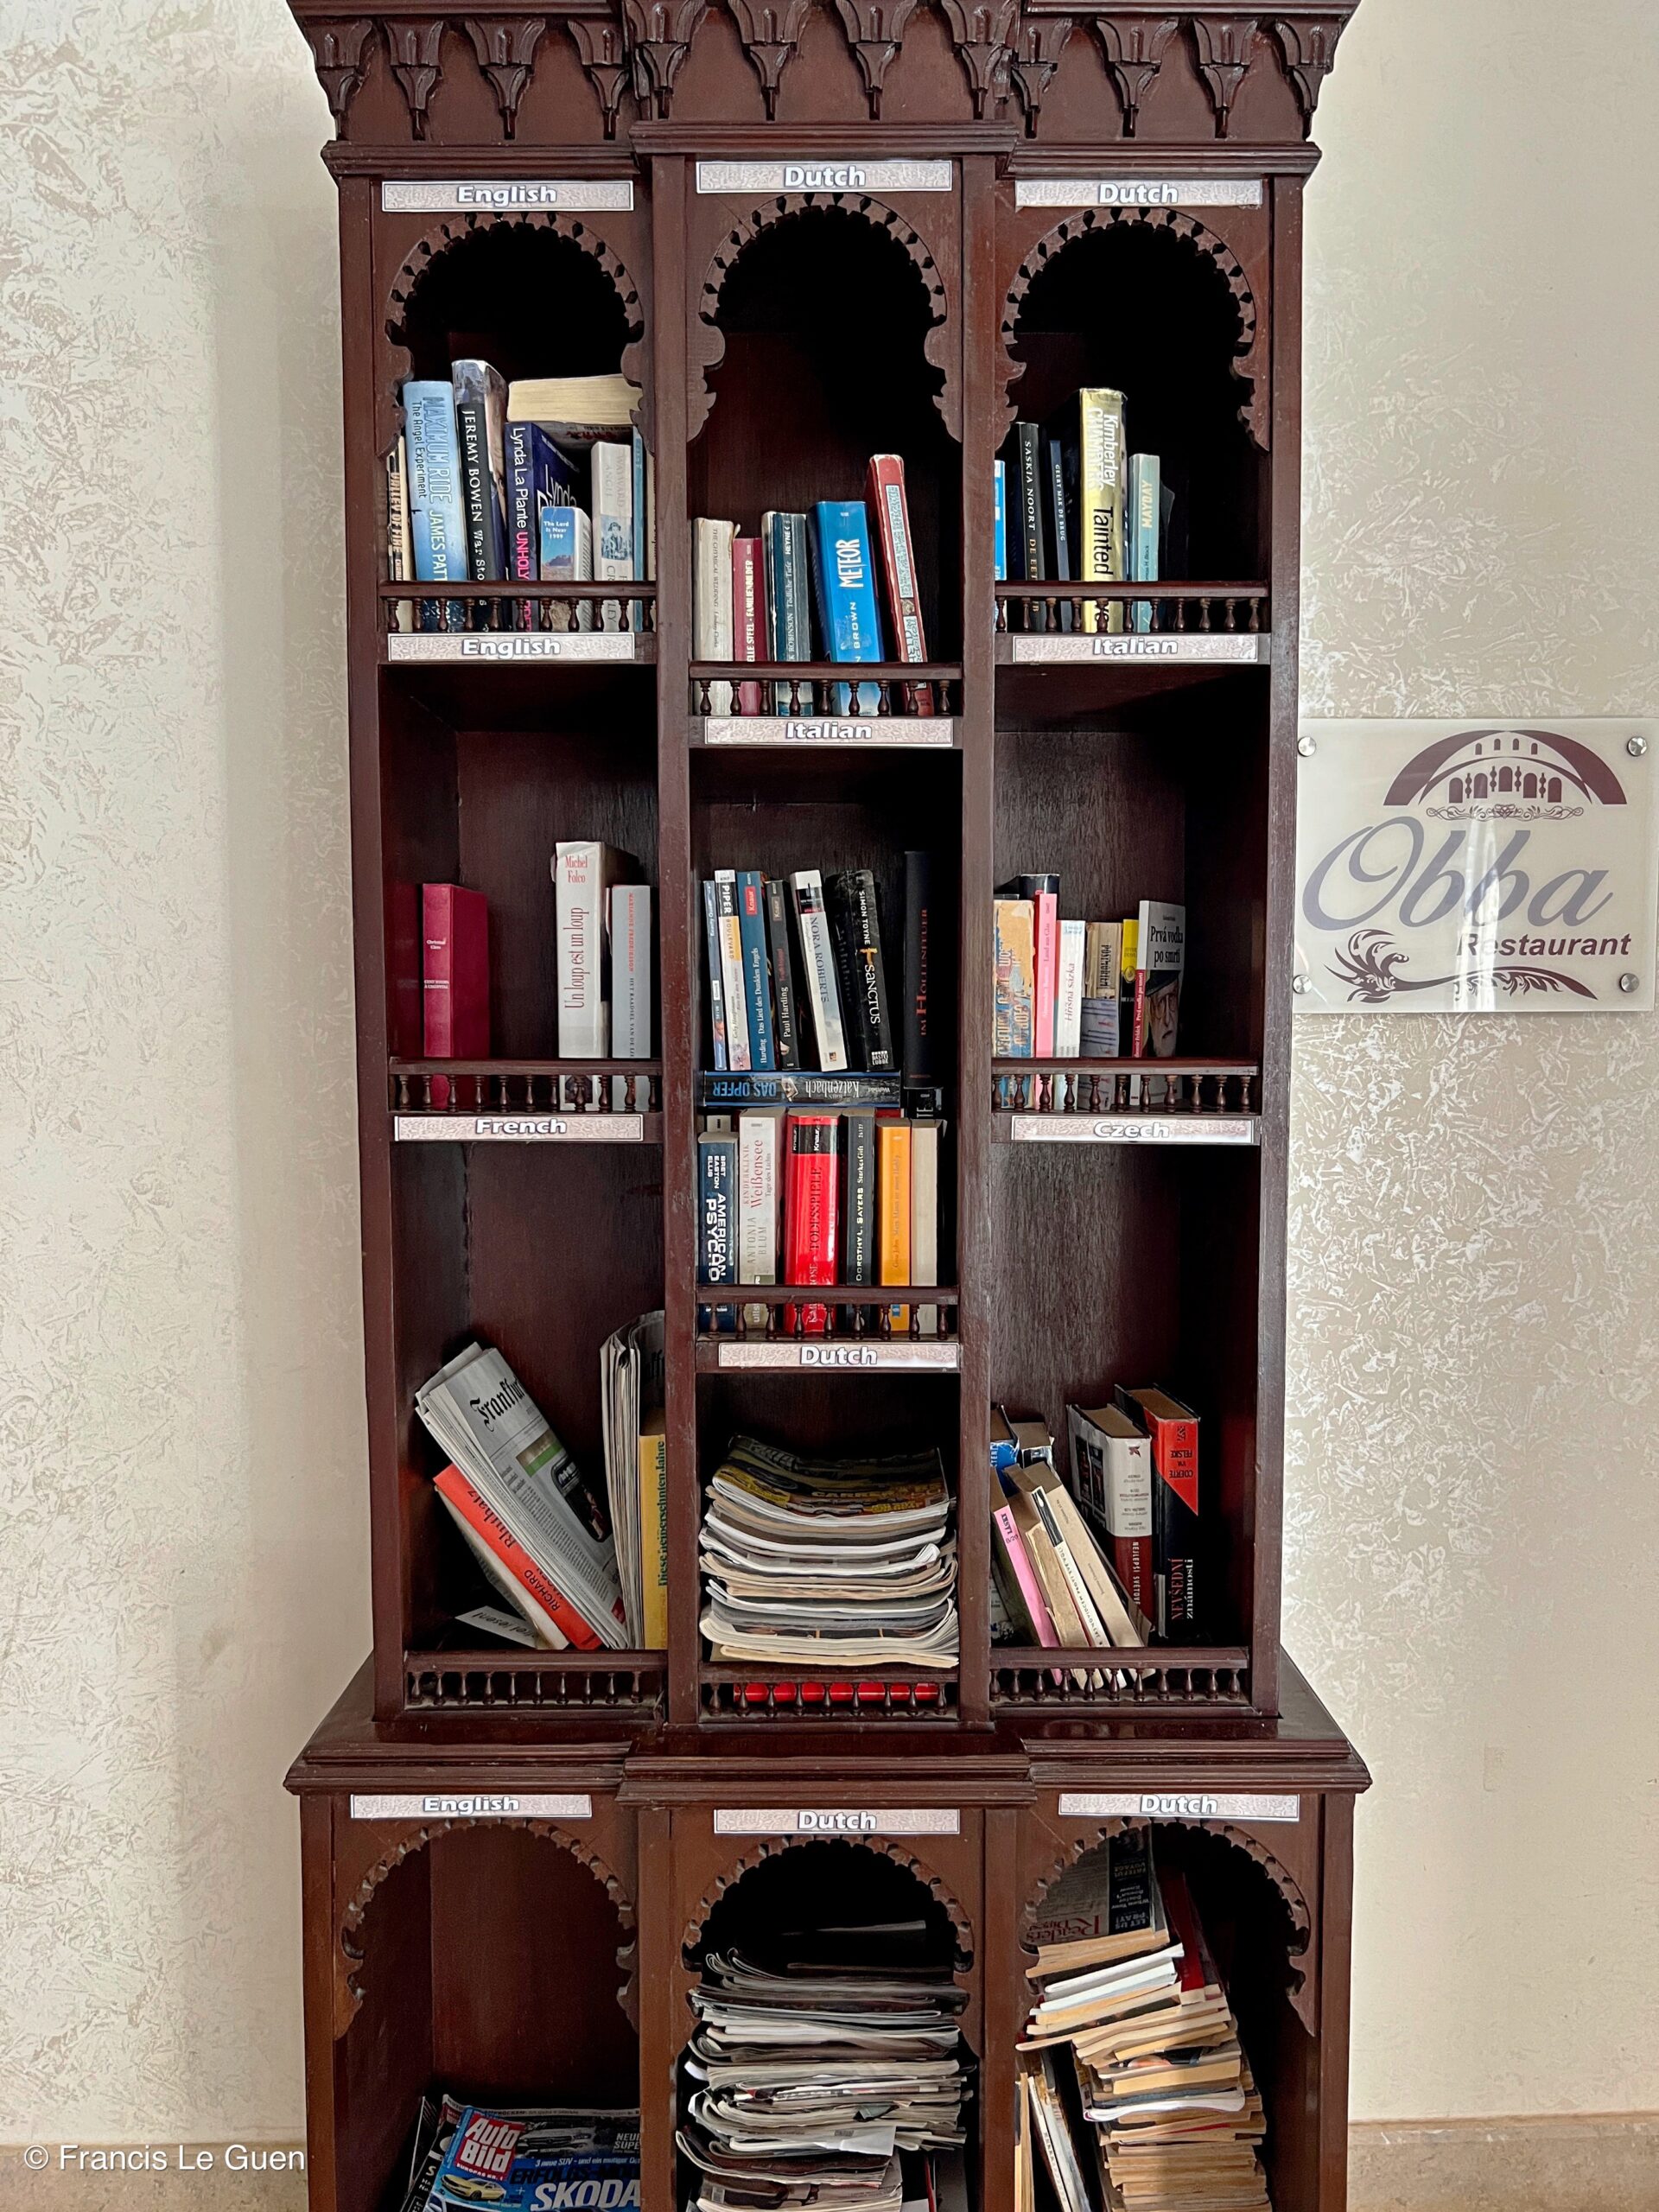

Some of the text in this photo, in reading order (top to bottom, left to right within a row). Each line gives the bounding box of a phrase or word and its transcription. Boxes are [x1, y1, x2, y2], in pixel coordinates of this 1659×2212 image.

[785, 166, 866, 188] Dutch
[458, 186, 557, 207] English
[1098, 182, 1179, 204] Dutch
[411, 401, 429, 499] The Angel Experiment
[1103, 414, 1118, 487] Kimberley
[423, 397, 452, 550] MAXIMUM RIDE JAMES
[462, 410, 483, 556] JEREMY BOWEN War
[511, 428, 530, 581] Lynda La Plante UNHOLY
[1024, 441, 1036, 554] SASKIA NOORT DE
[1141, 480, 1153, 529] MAYDAY
[392, 513, 401, 526] OF
[1058, 509, 1064, 518] DE
[1093, 506, 1114, 575] Tainted
[837, 538, 867, 648] BROWN METEOR
[462, 638, 561, 660] English
[1093, 639, 1178, 656] Italian
[786, 722, 873, 739] Italian
[564, 855, 588, 868] Michel
[1302, 816, 1613, 931] Obba
[568, 869, 586, 884] Folco
[722, 885, 733, 914] PIPER
[859, 890, 871, 945] SIMON TOYNE
[726, 918, 734, 959] BOULEVARD
[810, 917, 822, 950] NORA
[1150, 926, 1184, 944] Prvá vodka
[1457, 933, 1631, 957] Restaurant
[563, 907, 590, 1008] Un loup est un loup
[751, 947, 760, 968] Engels
[1154, 949, 1164, 968] po
[1165, 949, 1180, 963] smrti
[814, 952, 830, 1003] ROBERTS
[1064, 963, 1076, 988] sázka
[755, 1008, 764, 1021] Lied
[780, 986, 791, 1019] Harding
[920, 1020, 926, 1037] IM
[630, 1037, 636, 1046] DE
[713, 1080, 860, 1098] Katzenbach DAS OPFER
[475, 1118, 567, 1135] French
[1094, 1122, 1170, 1138] Czech
[747, 1140, 764, 1265] ANTONIA Weißensee
[809, 1166, 823, 1251] TODESSPIELE
[717, 1192, 727, 1276] AMERICAN
[758, 1226, 767, 1255] BLUM
[800, 1345, 878, 1364] Dutch
[1170, 1450, 1192, 1459] FELSKE
[1131, 1541, 1141, 1573] NEJLEPŠÍ
[524, 1569, 561, 1611] RICHARD
[1170, 1558, 1184, 1620] NEVŠEDNÍ
[1184, 1558, 1193, 1620] známosti
[423, 1796, 519, 1815] English
[1141, 1794, 1217, 1814] Dutch
[798, 1810, 877, 1830] Dutch
[1115, 1912, 1146, 1923] PRAY!
[1128, 1918, 1147, 1927] LET
[464, 2117, 521, 2151] Auto
[461, 2139, 512, 2173] Bild
[558, 2158, 573, 2166] SUV
[456, 2163, 486, 2178] EUROPAS
[531, 2179, 640, 2212] SKODA
